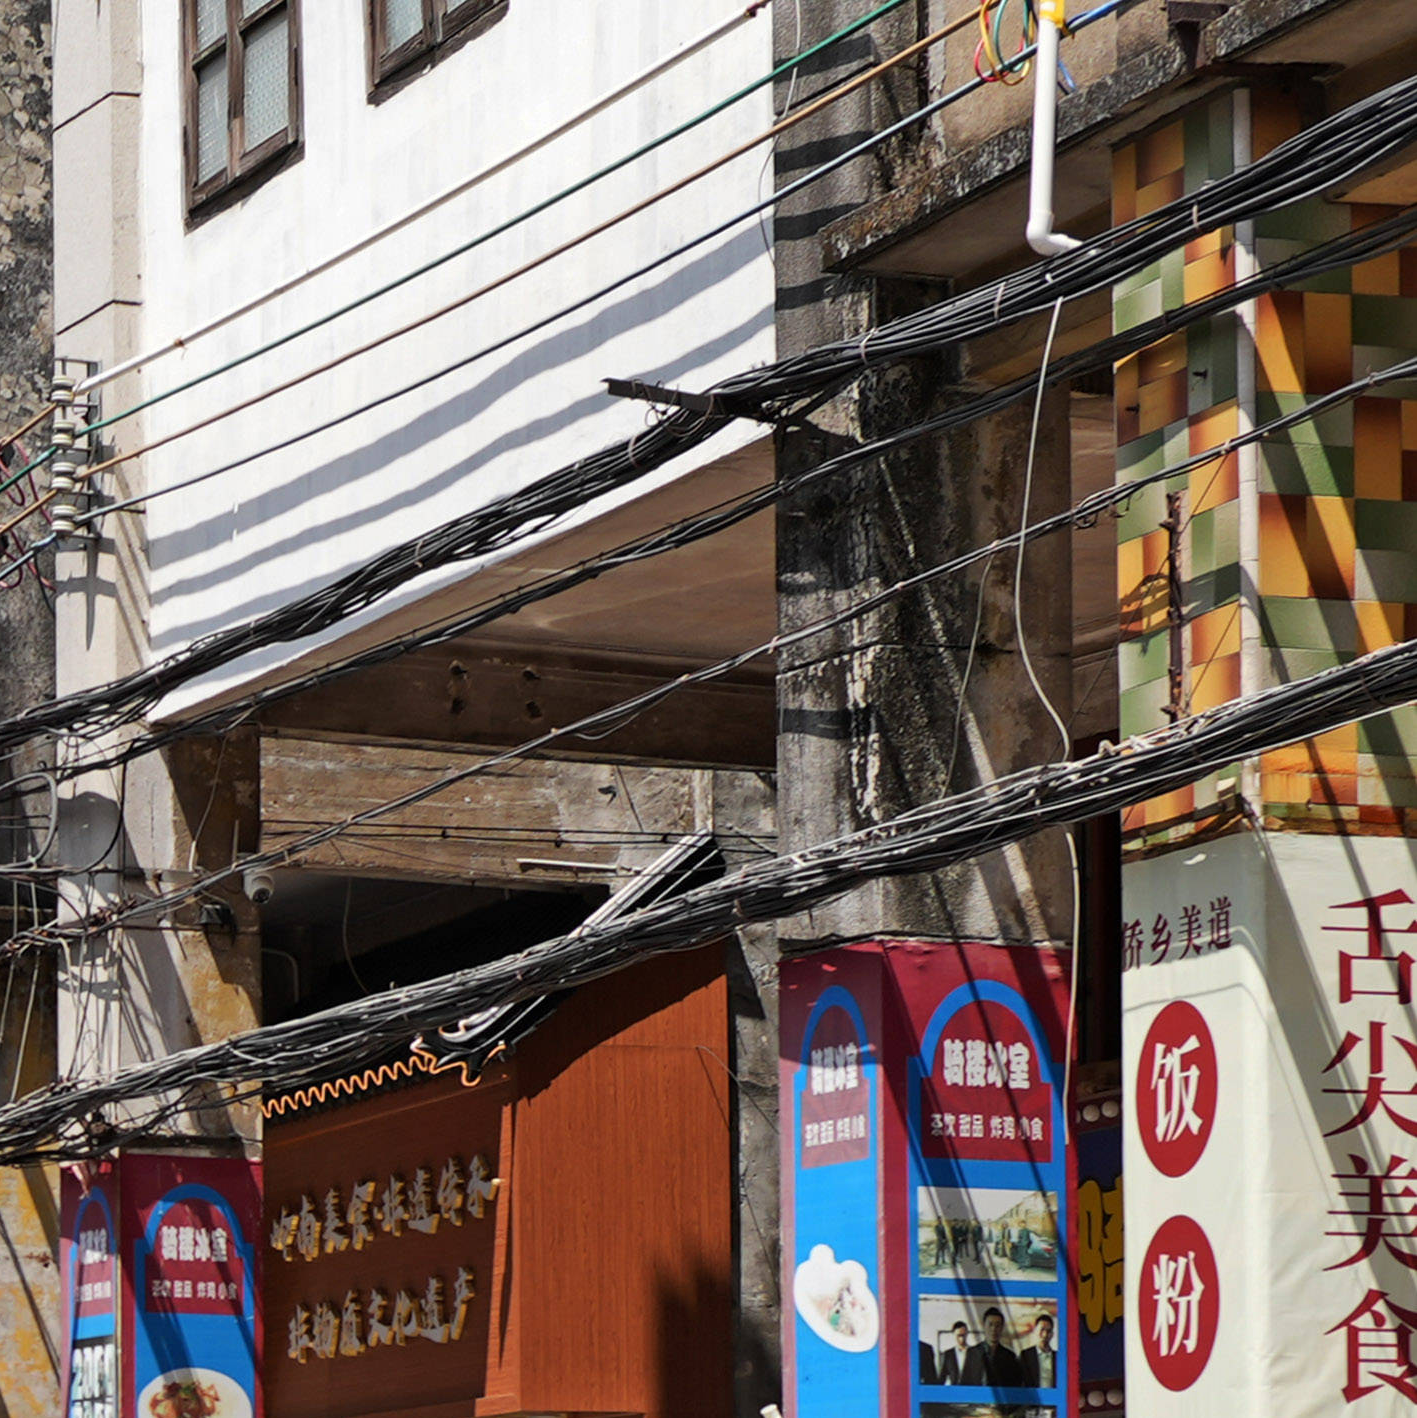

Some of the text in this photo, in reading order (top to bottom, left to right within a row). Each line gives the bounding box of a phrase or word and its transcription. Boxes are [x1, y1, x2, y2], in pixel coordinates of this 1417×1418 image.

[942, 1038, 1031, 1090] 骑楼冰室
[1150, 1035, 1204, 1143] 饭
[959, 1114, 984, 1138] 甜品
[990, 1115, 1016, 1140] 炸鸡
[1018, 1117, 1044, 1141] 小食
[161, 1225, 228, 1262] 骑楼冰室
[288, 1266, 476, 1365] 非物质文化遗产
[1151, 1249, 1204, 1358] 粉
